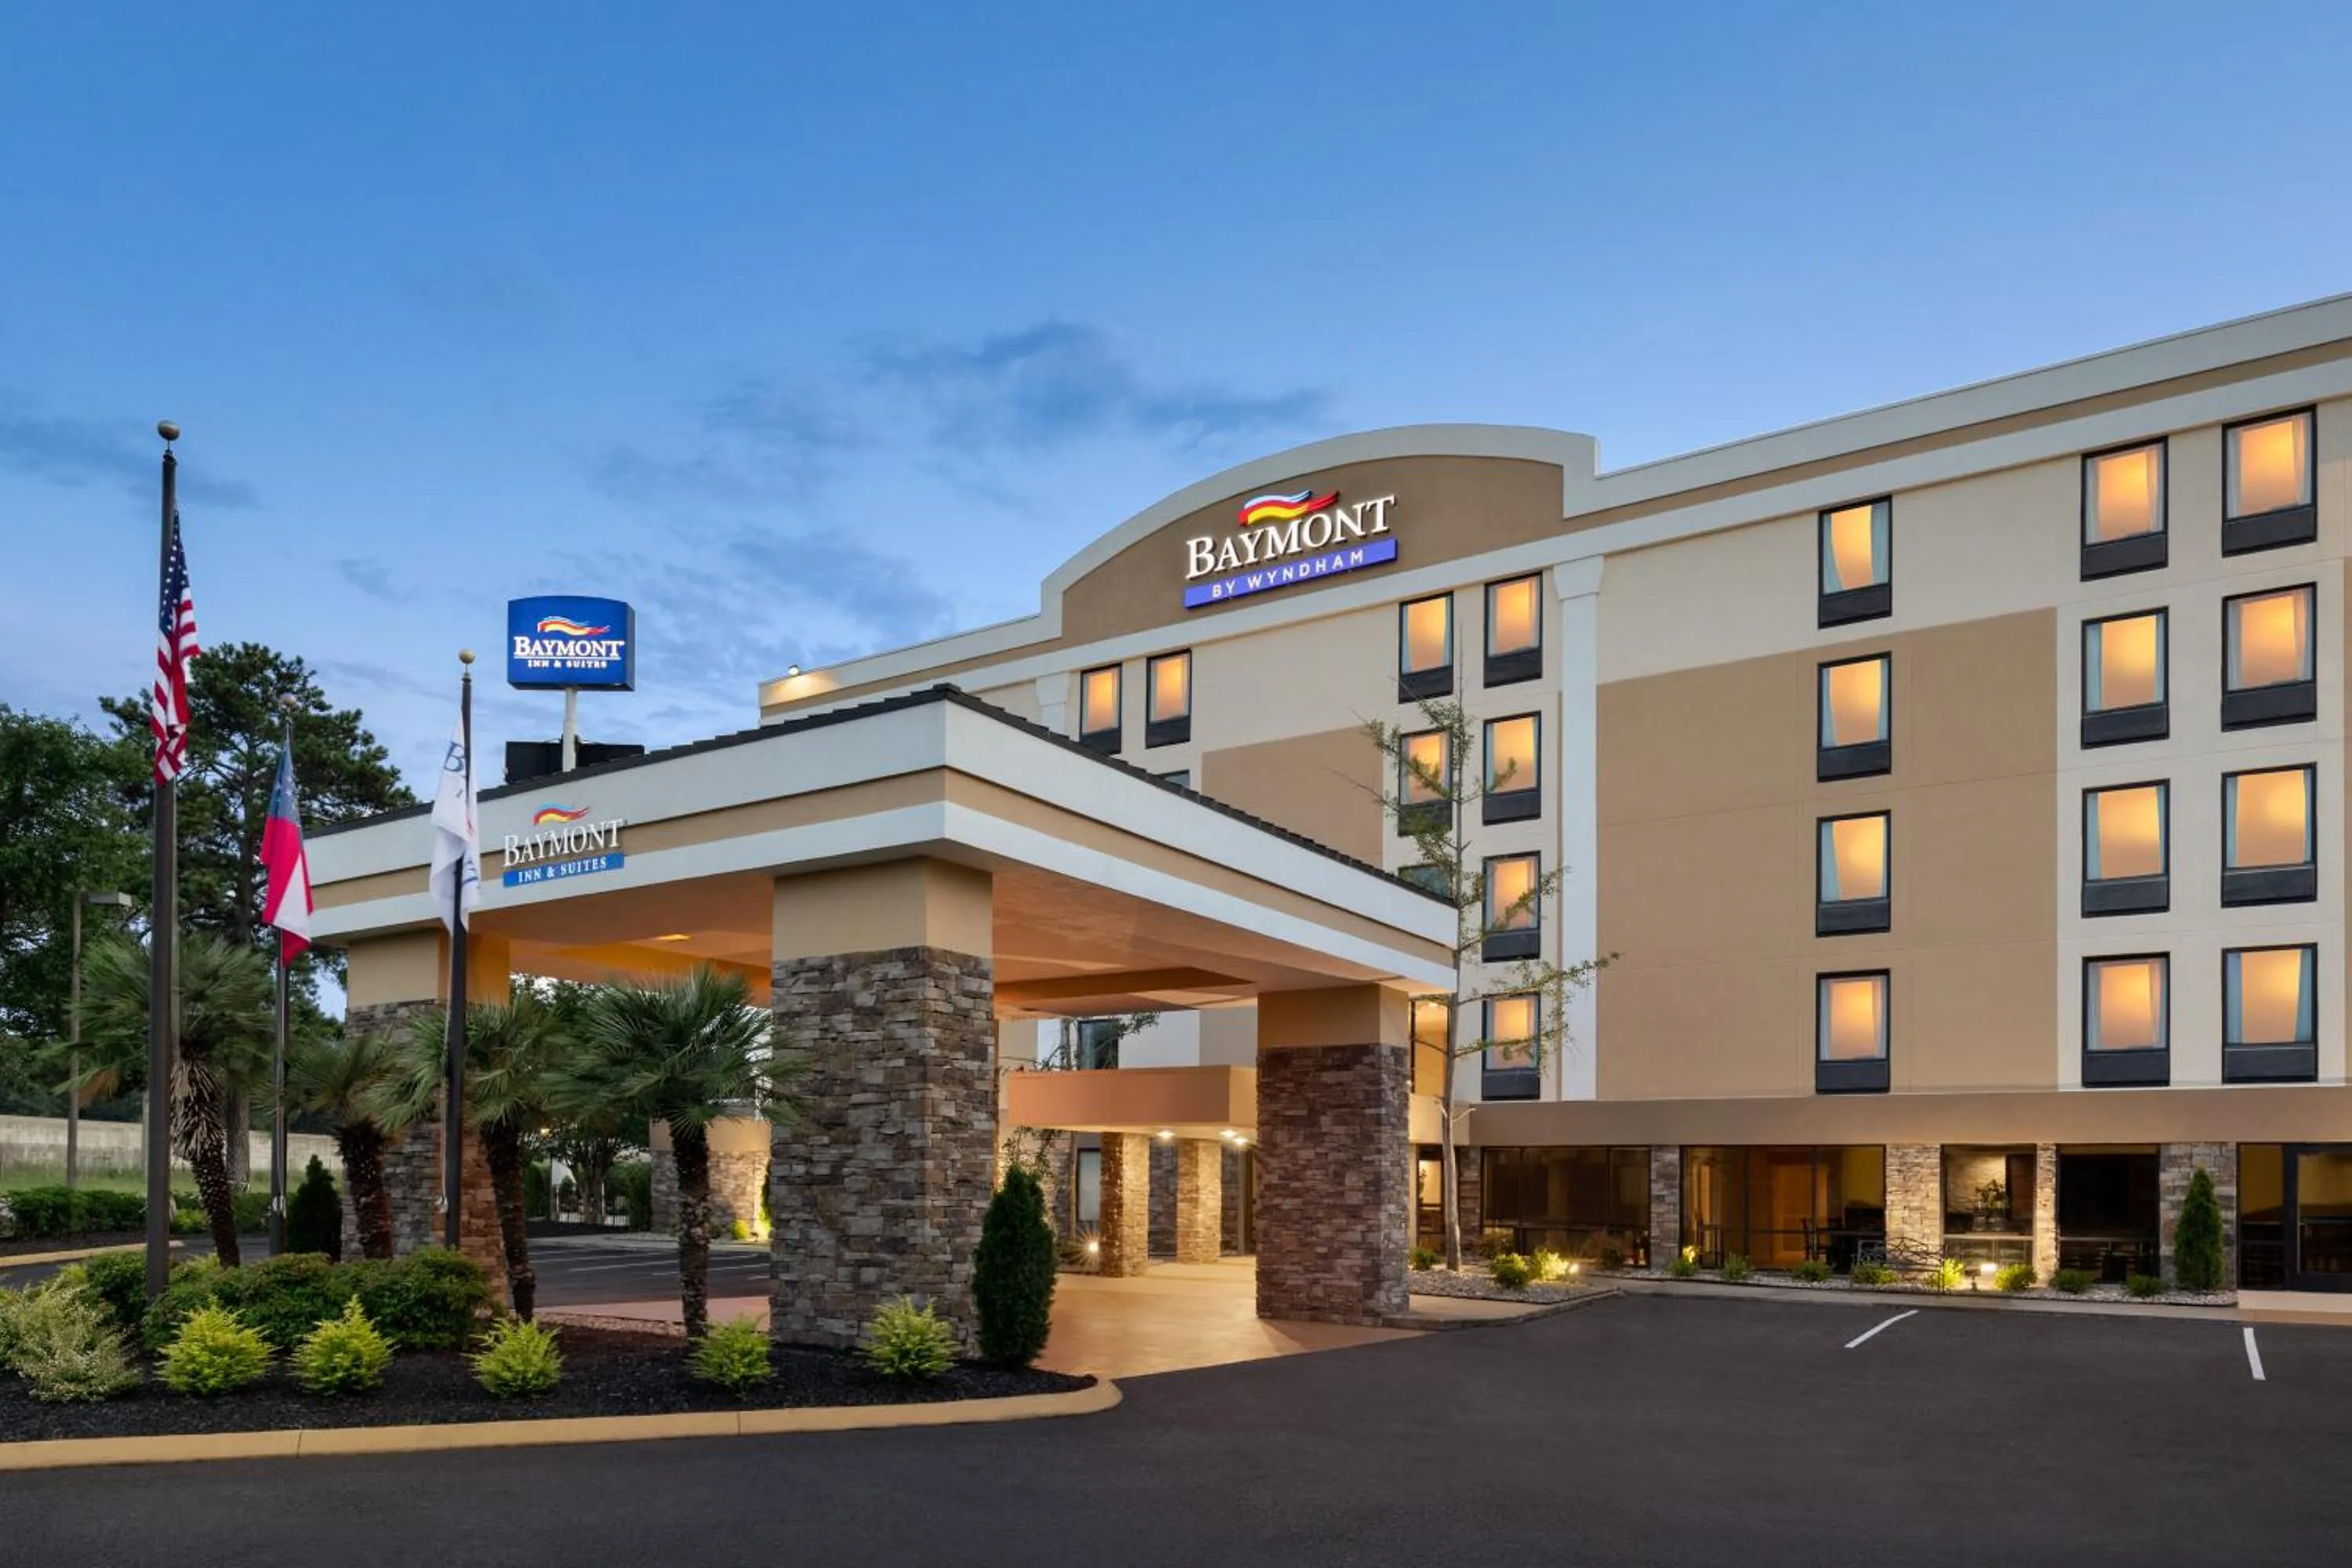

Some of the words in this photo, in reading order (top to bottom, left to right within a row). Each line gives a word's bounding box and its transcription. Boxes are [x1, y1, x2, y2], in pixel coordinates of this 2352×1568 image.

[1185, 495, 1396, 579] BAYMONT
[1212, 581, 1236, 597] BY
[1247, 550, 1363, 589] WYNDHAM
[514, 636, 625, 656] BAYMONT
[527, 659, 549, 668] INN
[554, 659, 562, 669] &
[566, 659, 608, 669] SUITES
[503, 818, 622, 867] BAYMONT
[518, 869, 541, 883] INN
[546, 866, 555, 878] &
[561, 857, 607, 876] SUITES
